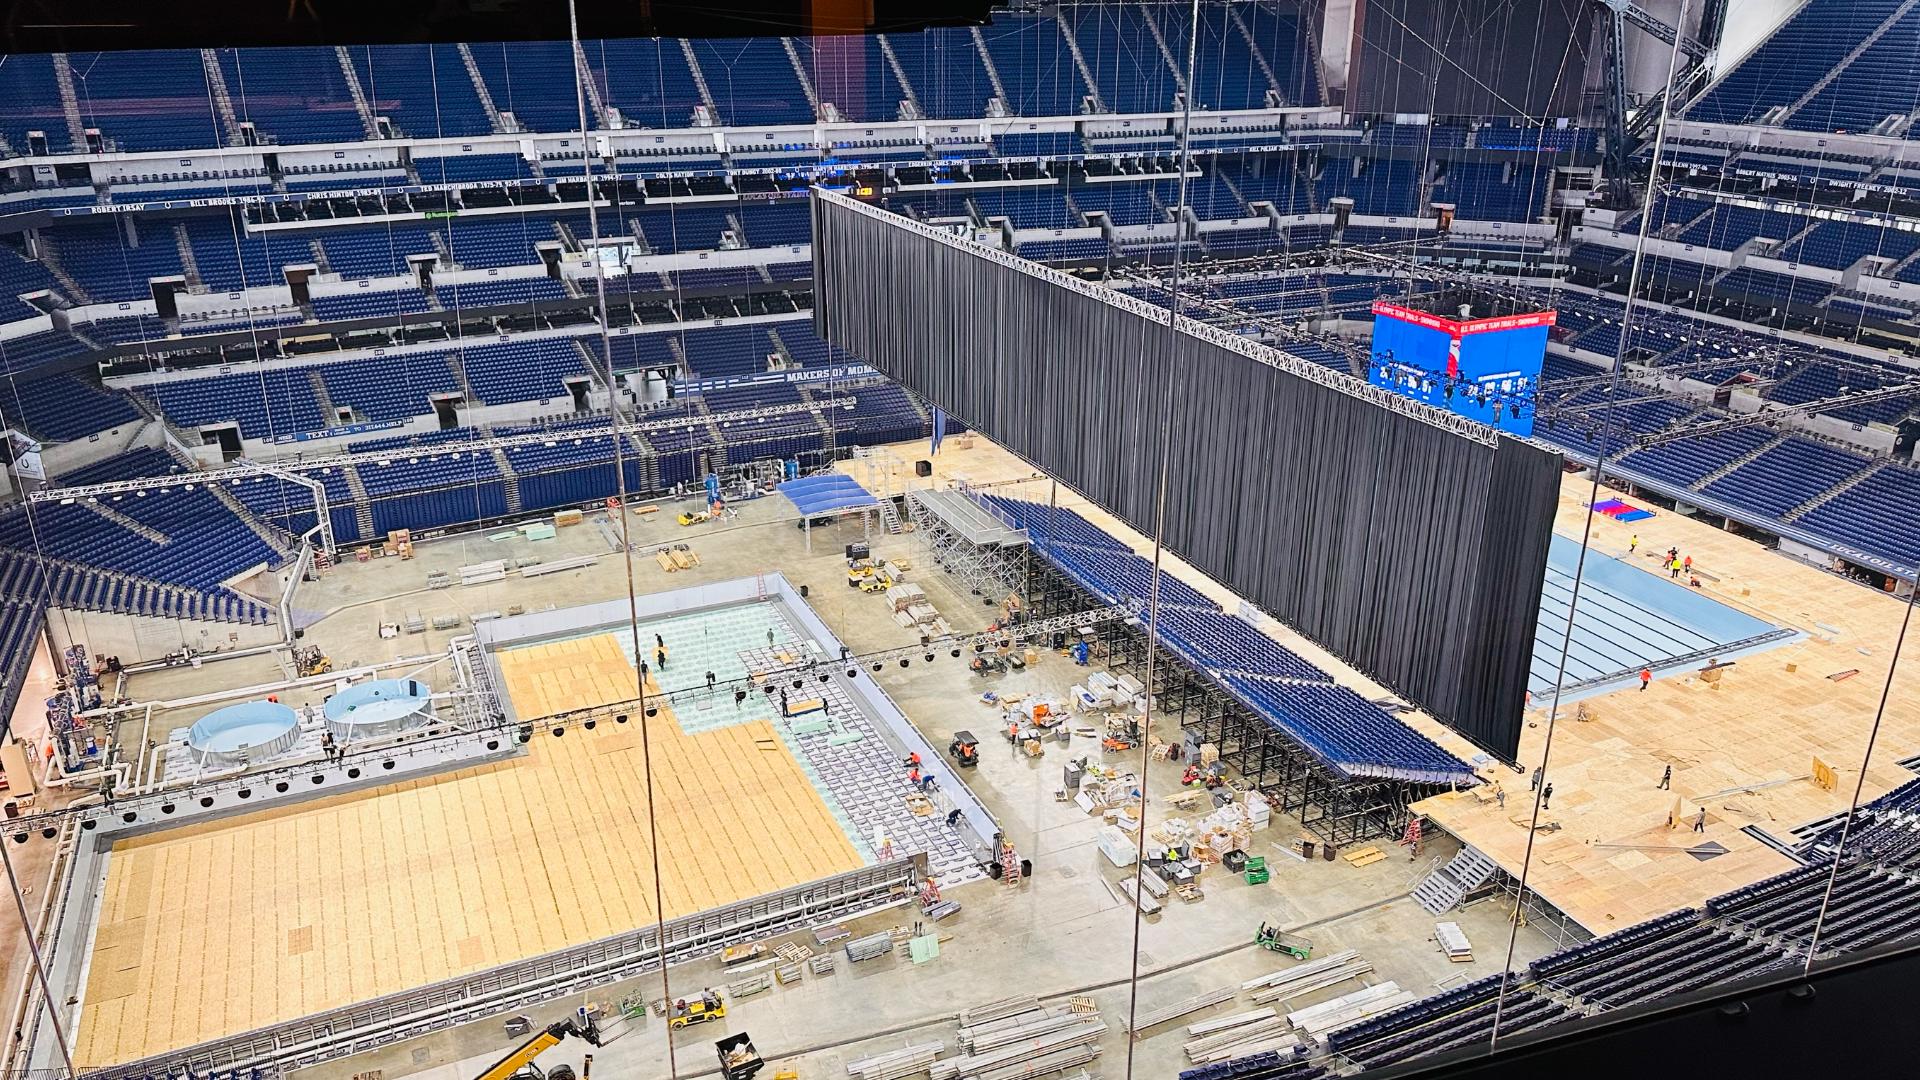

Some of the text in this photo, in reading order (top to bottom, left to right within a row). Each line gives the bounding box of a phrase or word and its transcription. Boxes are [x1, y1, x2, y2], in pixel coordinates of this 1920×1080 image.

[91, 203, 145, 214] ROBERT IRSAY
[786, 369, 830, 382] MAKERS
[847, 364, 878, 374] MOM
[305, 430, 329, 440] TEXT
[1830, 543, 1871, 561] LUCAS
